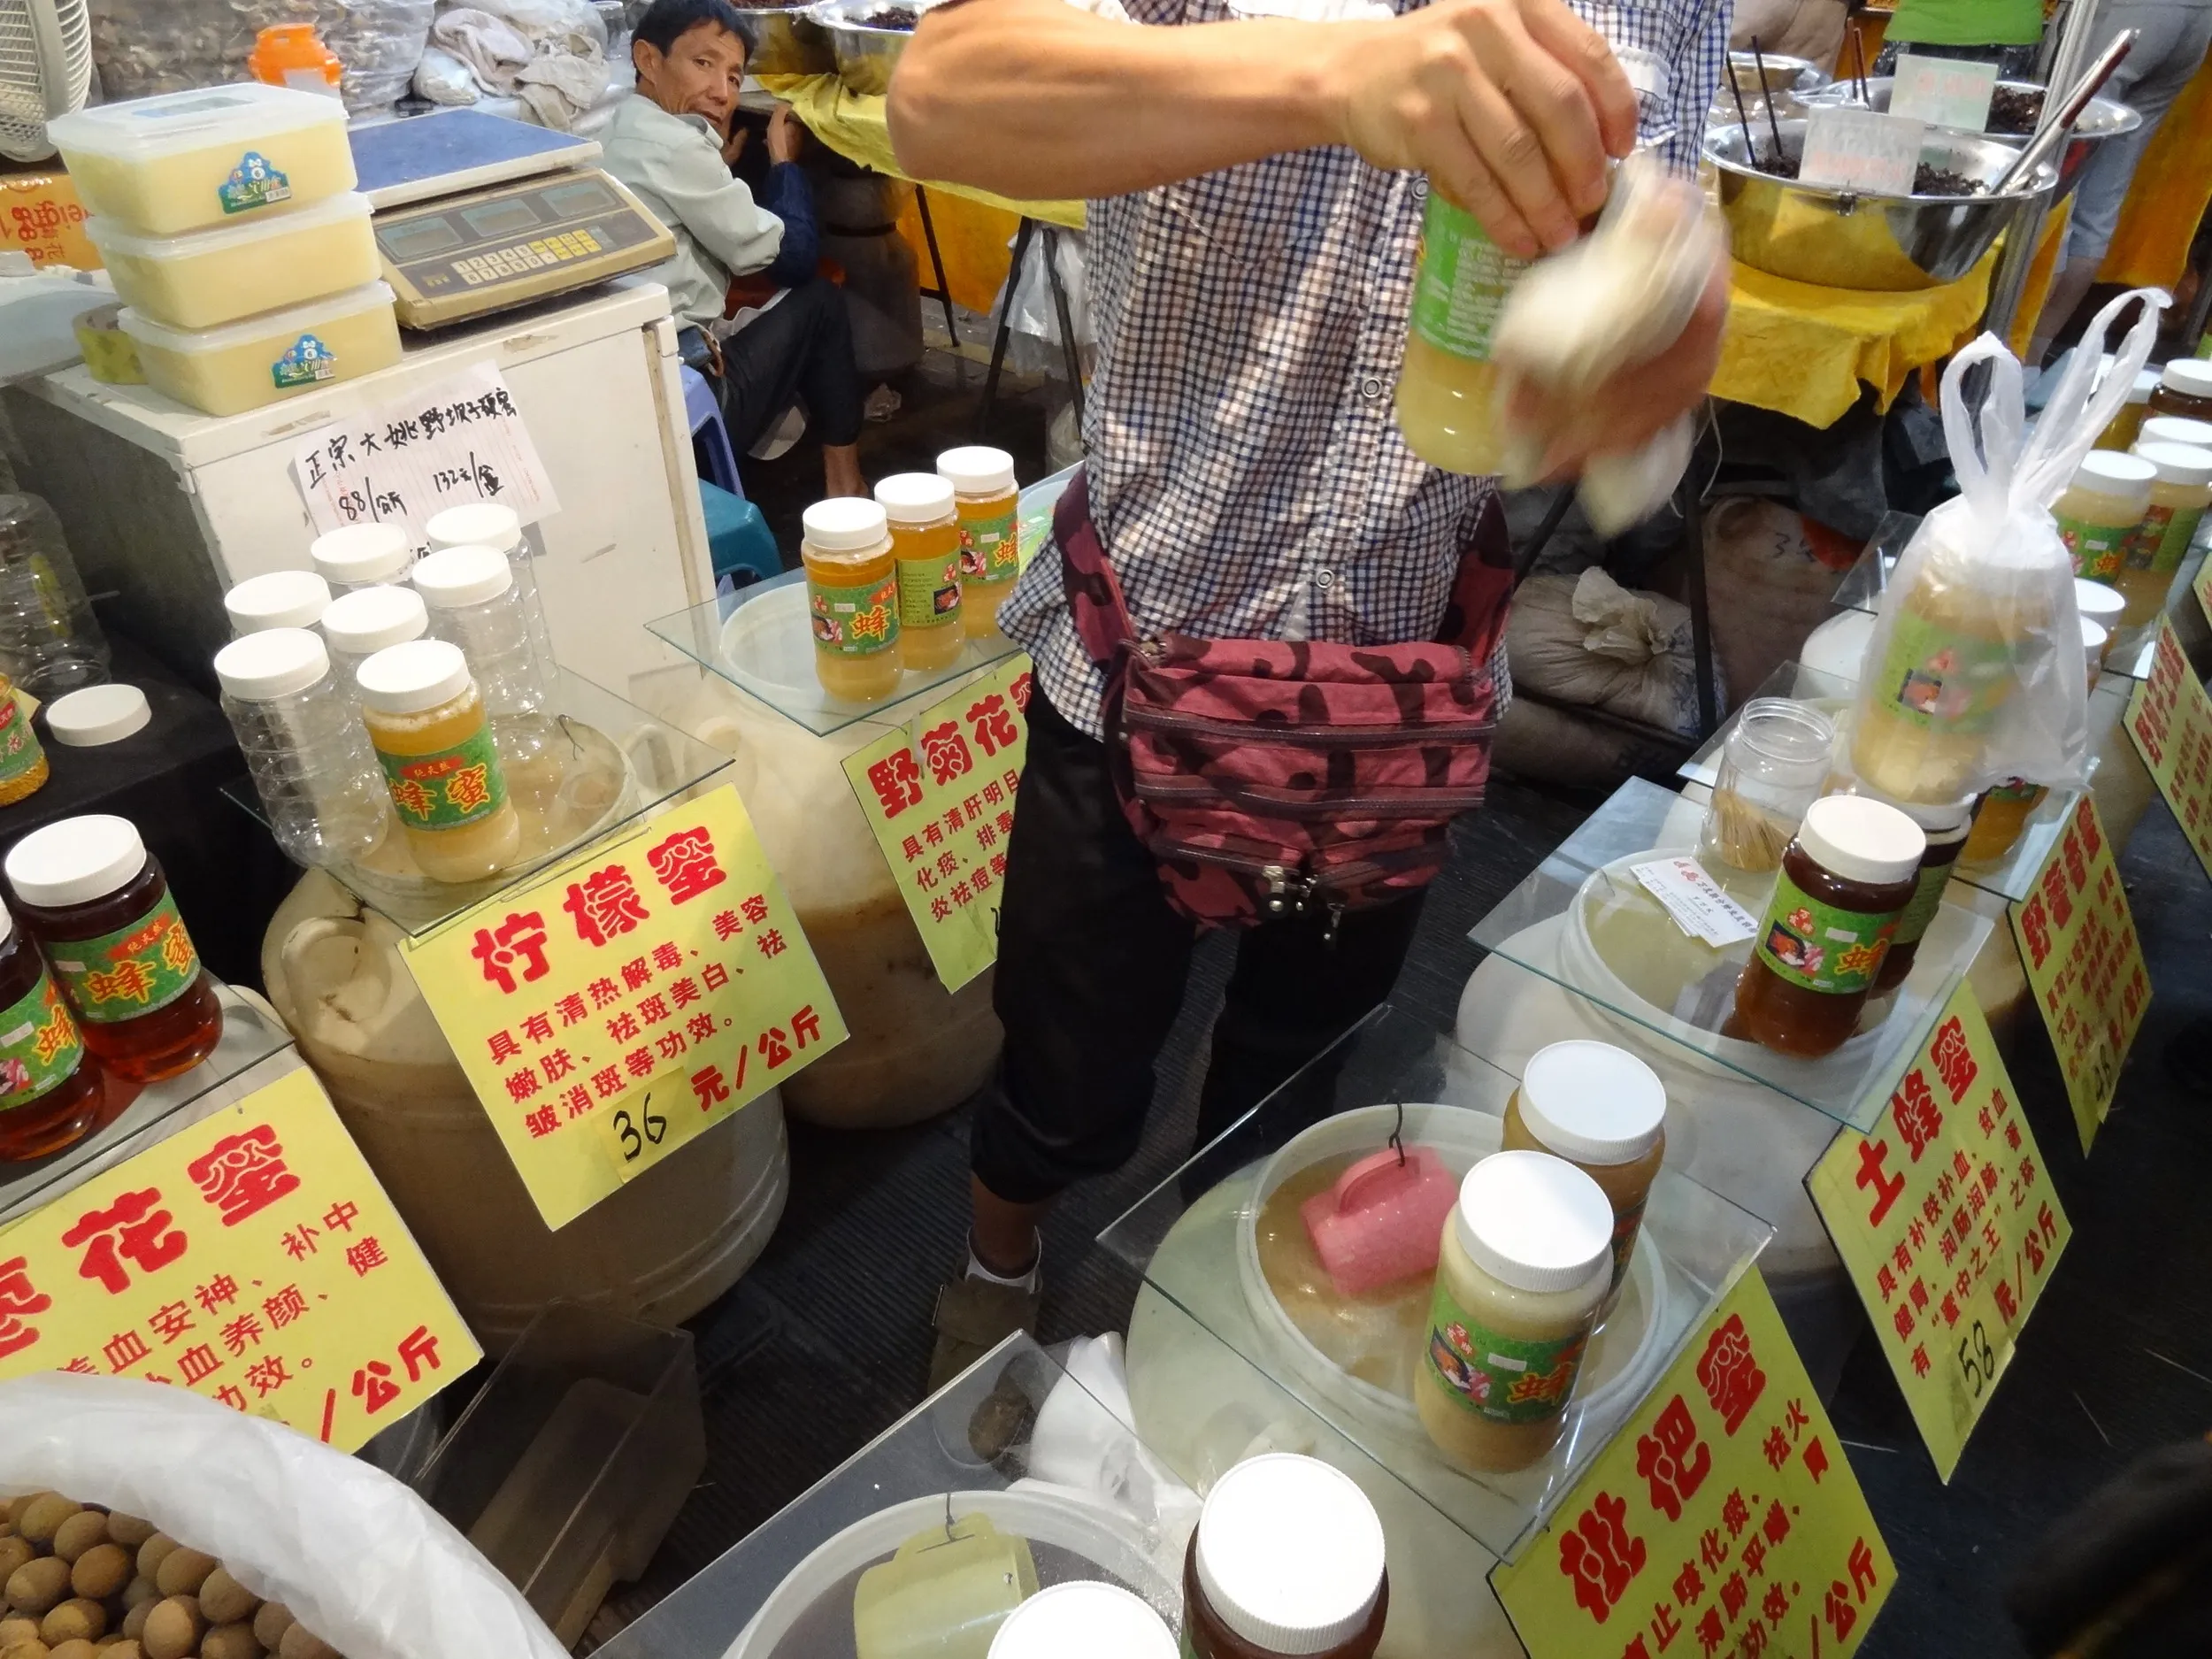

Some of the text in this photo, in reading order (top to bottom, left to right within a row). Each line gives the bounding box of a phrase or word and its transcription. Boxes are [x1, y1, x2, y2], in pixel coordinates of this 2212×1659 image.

[849, 604, 892, 641] 蜂
[388, 762, 490, 821] 蜂蜜
[902, 768, 1019, 864] 具有清肝明目
[916, 810, 1014, 892] 化痰、排毒
[472, 826, 727, 995] 柠檬蜜
[930, 851, 1008, 924] 炎祛痘等
[487, 893, 771, 1066] 具有清热解毒、美容
[504, 928, 788, 1105] 嫩肤、祛斑美白、祛
[524, 1012, 733, 1140] 皱消斑等功效。
[612, 1003, 823, 1163] 36 元/公斤
[1855, 1015, 1979, 1228] 土蜂蜜
[1876, 1087, 2009, 1304] 具有补铁补血、贫血
[1892, 1118, 2024, 1343] 健胃、润肠润肺、著
[145, 1235, 389, 1386] 血养颜、健
[1958, 1199, 2058, 1398] 58 元/公斤
[280, 1324, 442, 1444] /公斤
[1558, 1312, 1767, 1624] 枇杷蜜
[1724, 1580, 1801, 1659] 功效。
